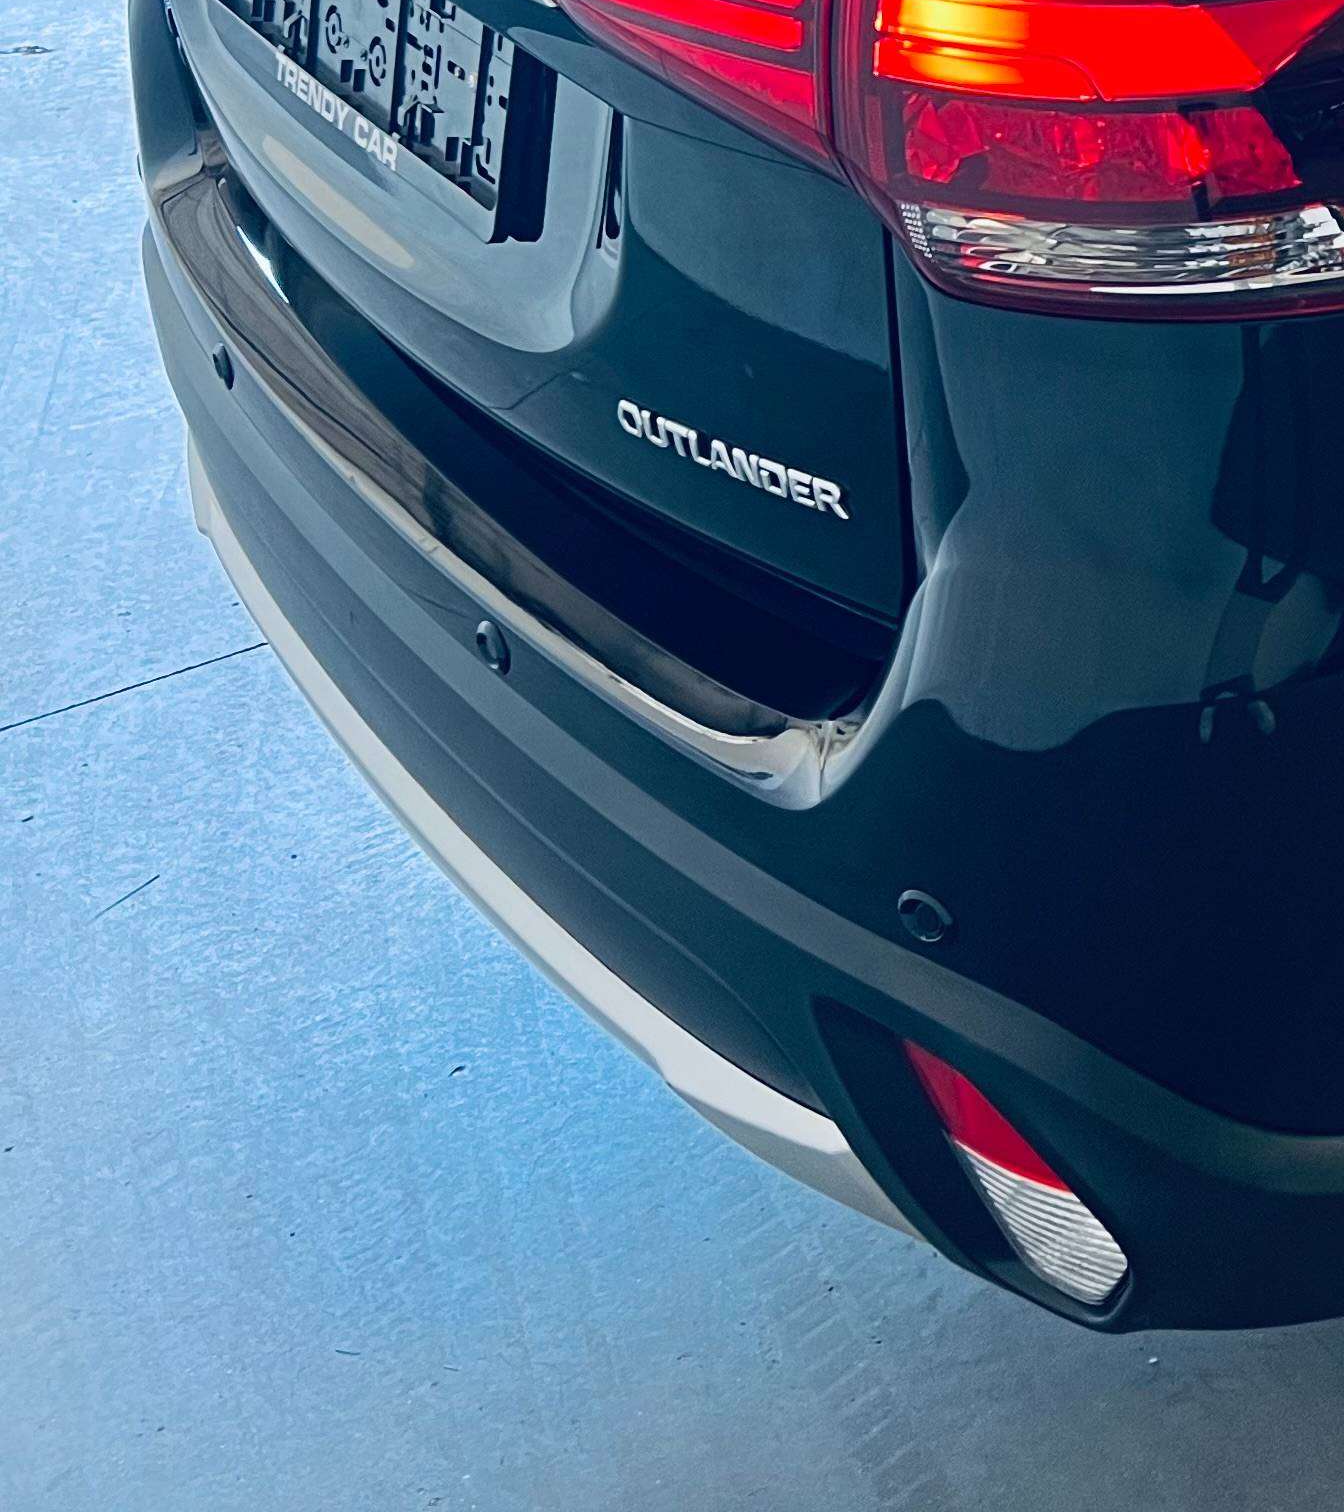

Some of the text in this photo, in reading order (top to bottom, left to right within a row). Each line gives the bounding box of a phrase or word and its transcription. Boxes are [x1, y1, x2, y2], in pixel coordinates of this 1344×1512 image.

[275, 51, 398, 172] TRENDY CAR
[616, 398, 850, 520] OUTLANDER
